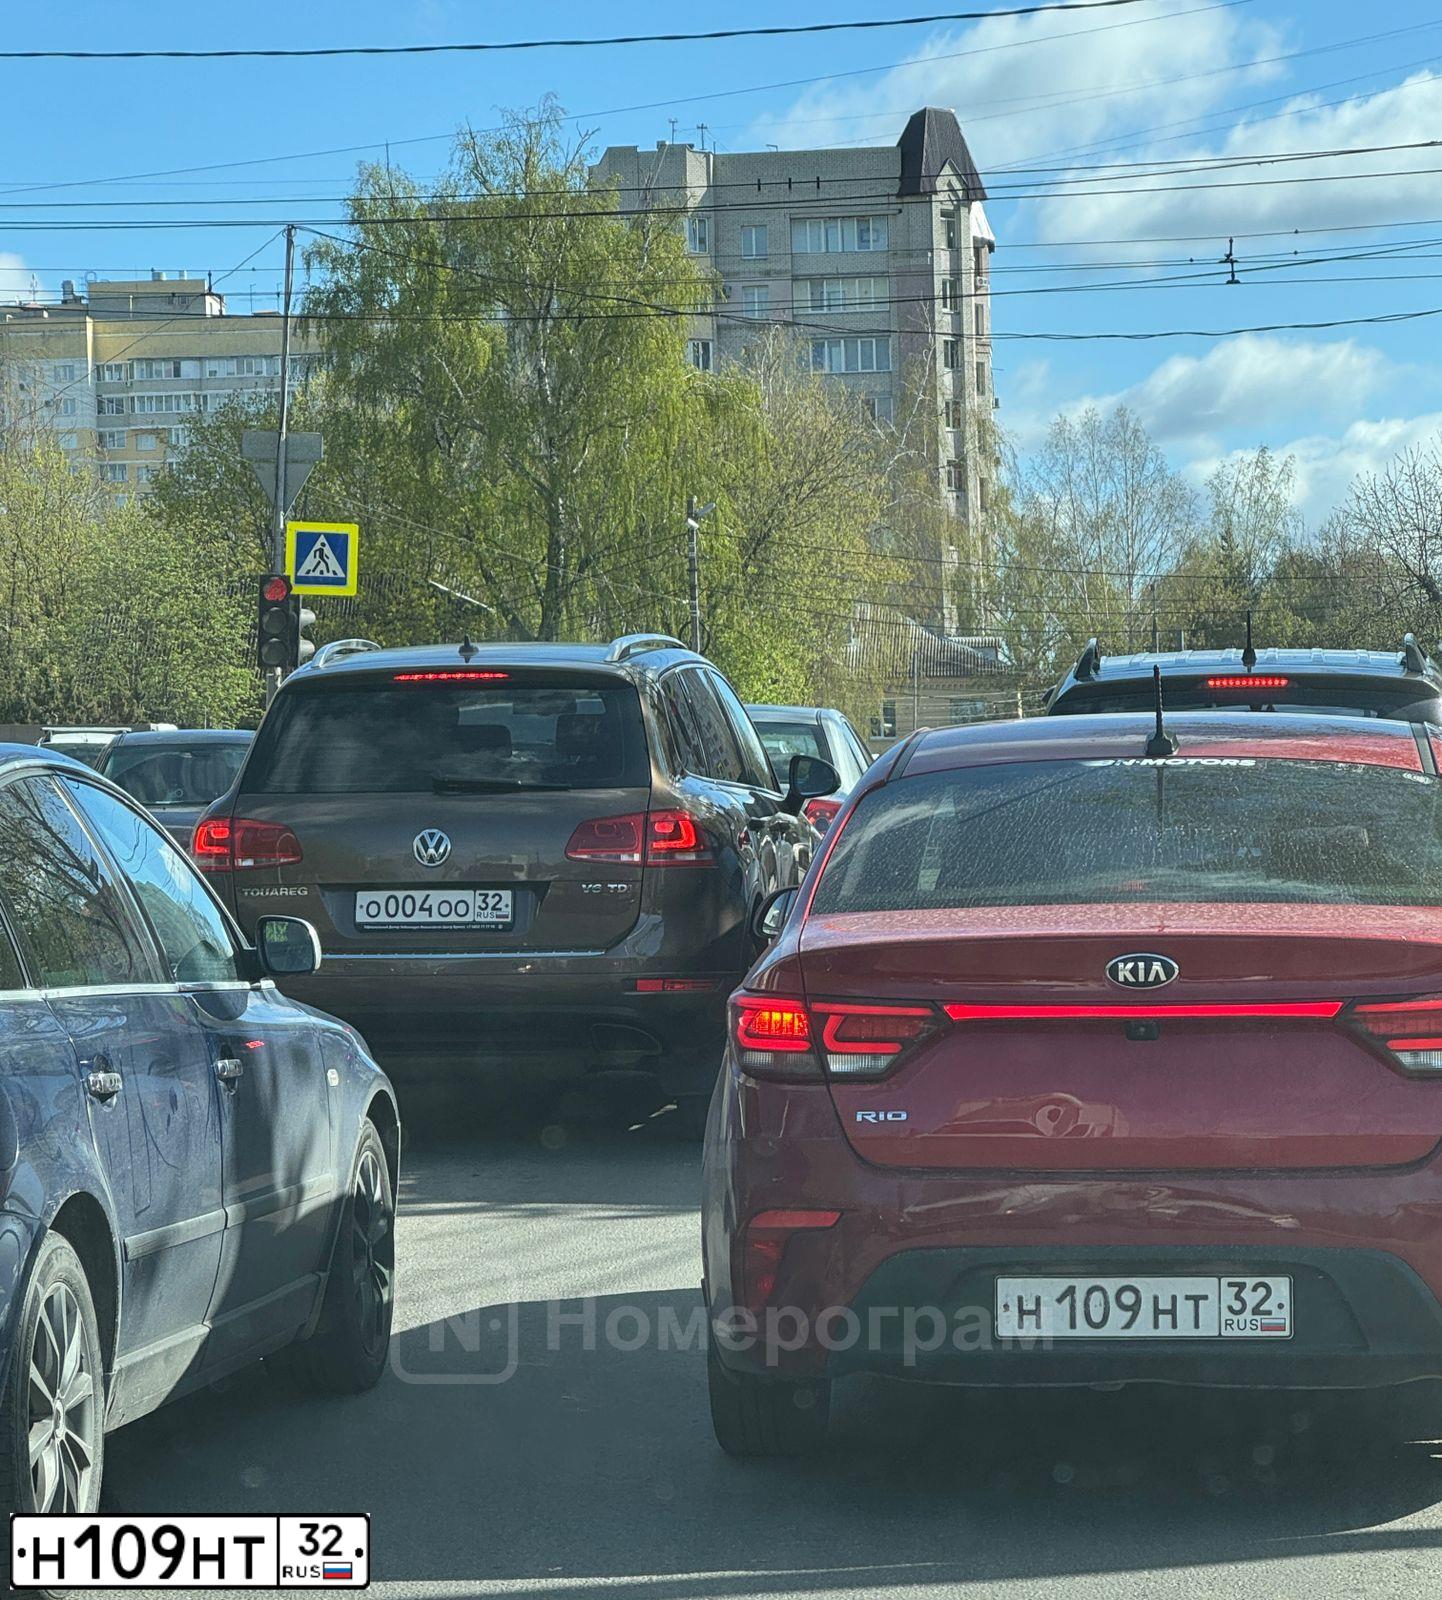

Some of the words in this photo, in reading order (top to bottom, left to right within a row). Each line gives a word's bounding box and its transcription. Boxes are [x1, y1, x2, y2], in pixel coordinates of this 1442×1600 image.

[242, 886, 309, 897] TOUAREG
[477, 892, 503, 912] 32
[476, 912, 496, 920] RUS
[1117, 961, 1167, 982] KIA
[856, 1111, 907, 1123] RIO
[1226, 1281, 1273, 1316] 32
[1224, 1318, 1259, 1332] RUS
